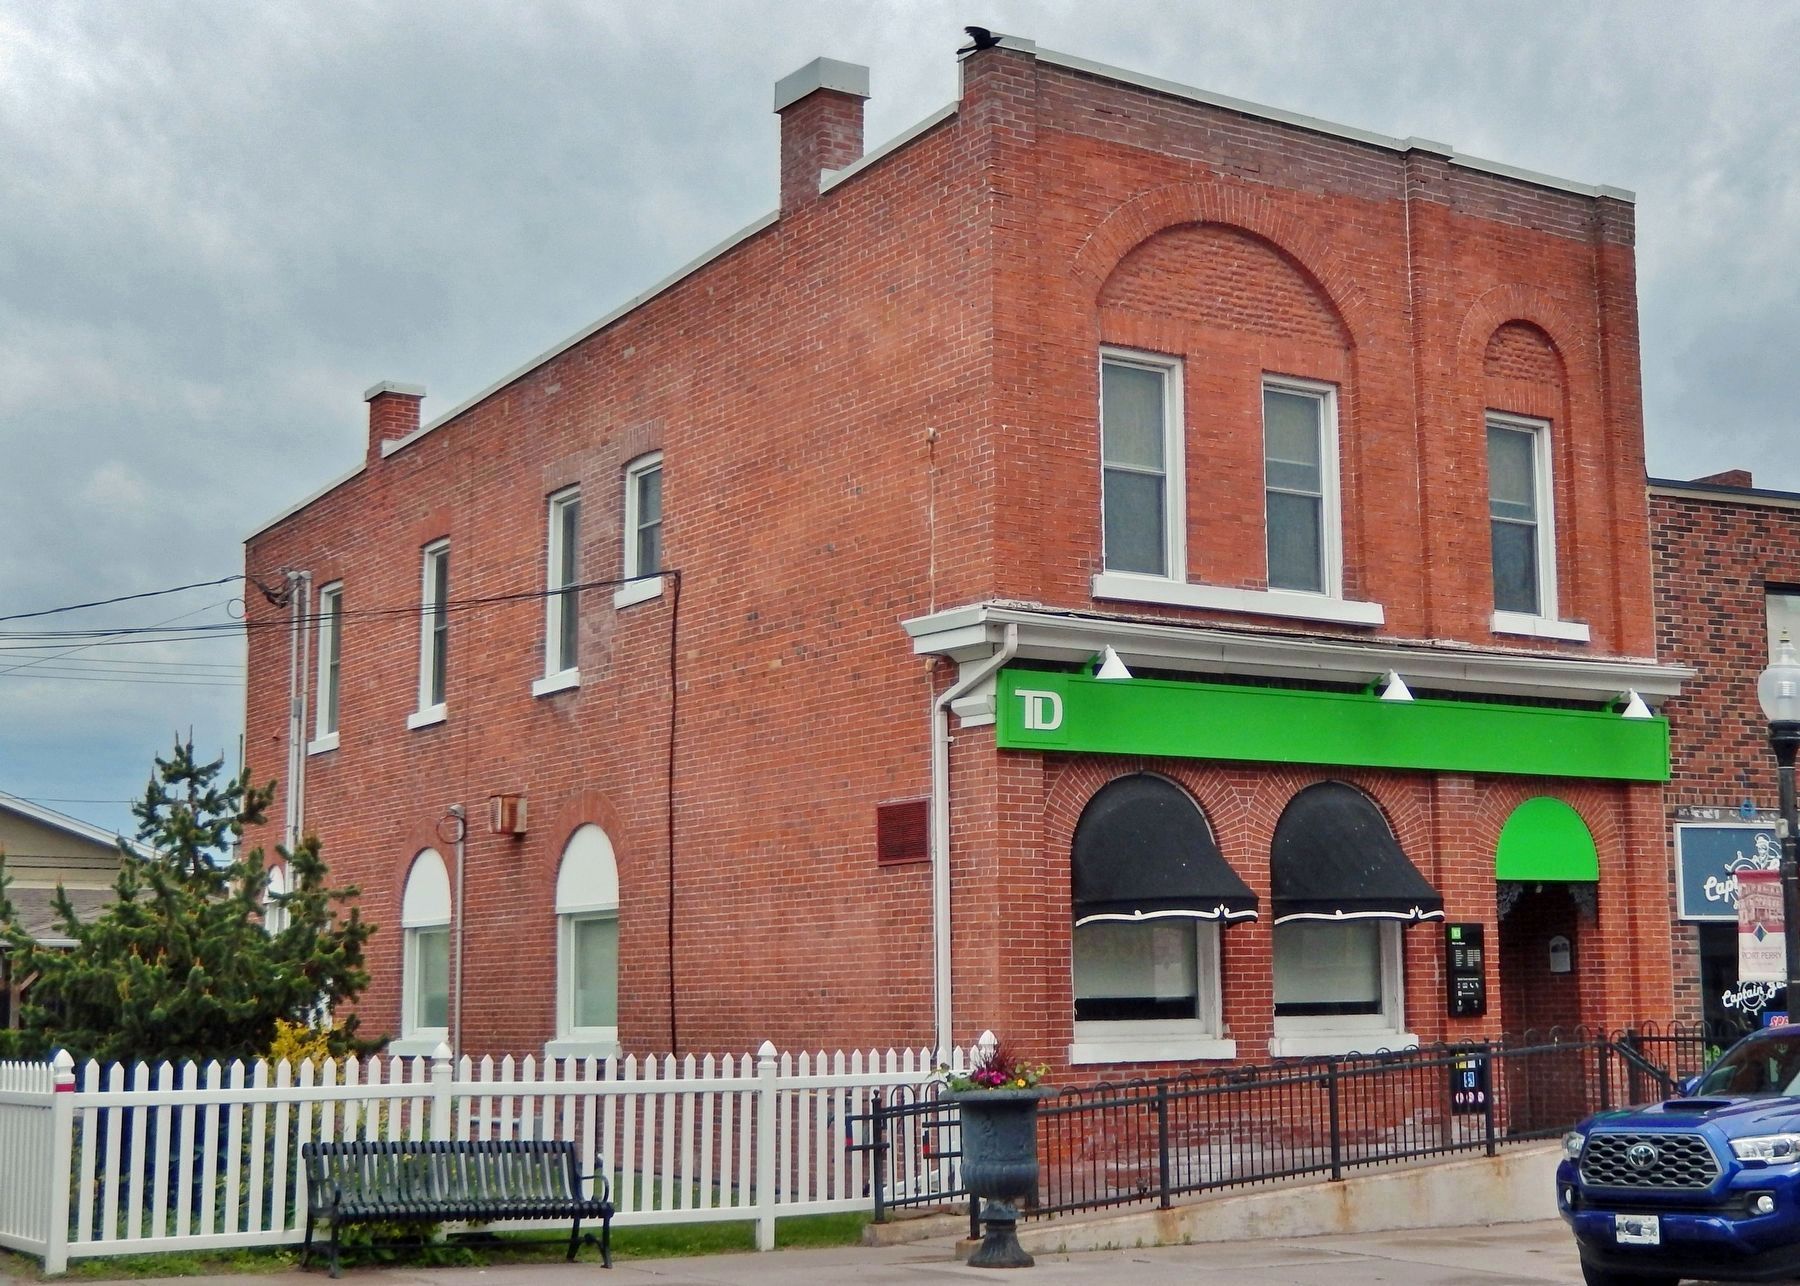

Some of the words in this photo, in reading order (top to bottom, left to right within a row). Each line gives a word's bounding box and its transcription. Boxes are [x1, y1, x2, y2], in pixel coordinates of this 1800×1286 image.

[1014, 689, 1063, 730] TD
[1761, 951, 1782, 960] PERRY
[1721, 985, 1763, 1008] Captain
